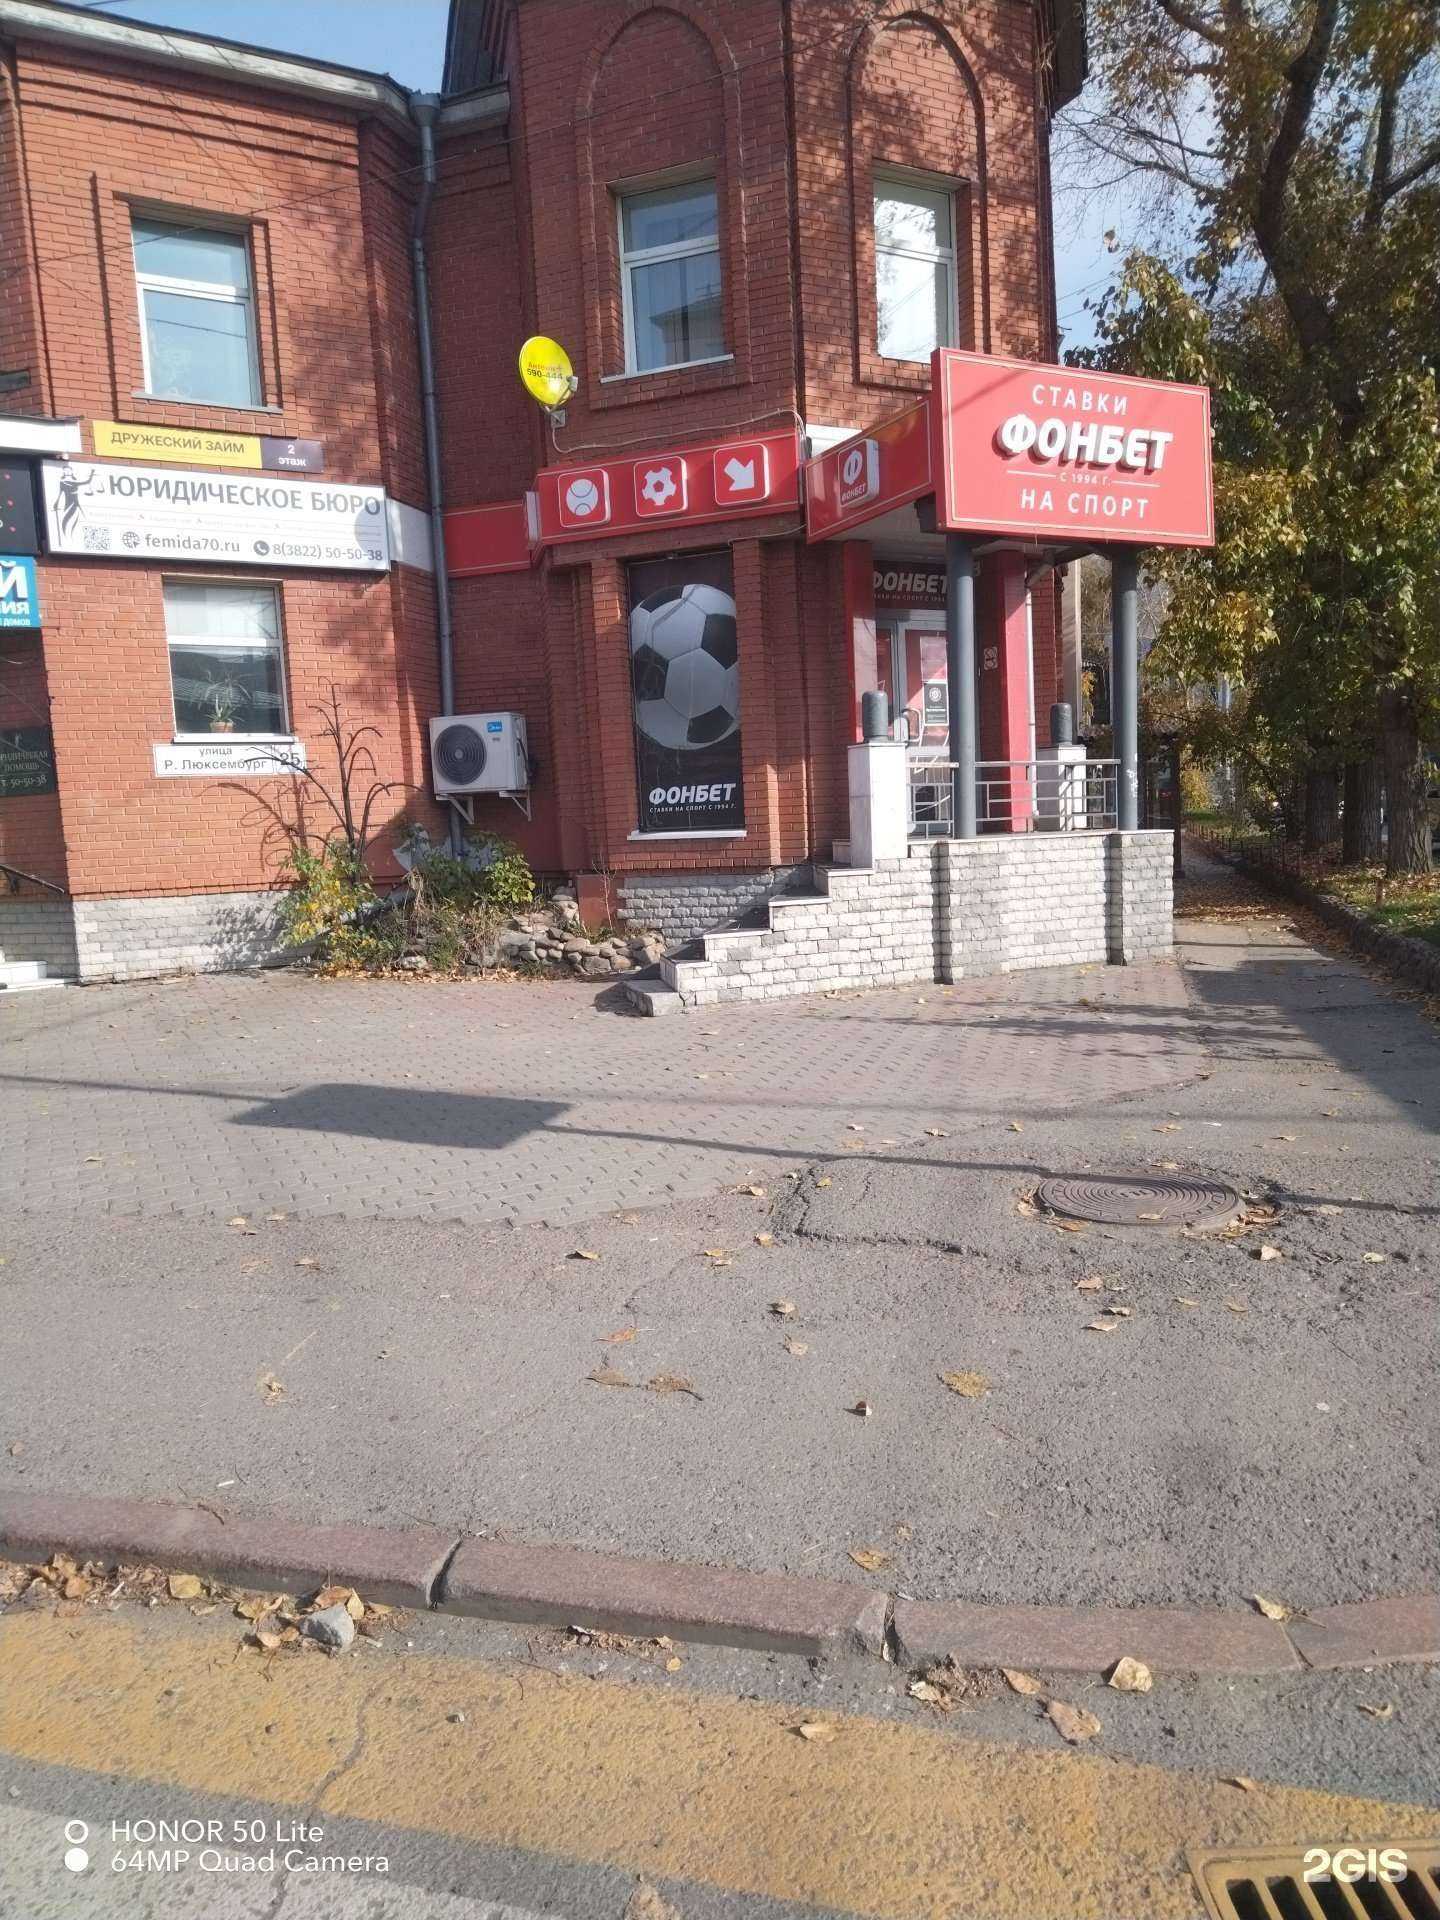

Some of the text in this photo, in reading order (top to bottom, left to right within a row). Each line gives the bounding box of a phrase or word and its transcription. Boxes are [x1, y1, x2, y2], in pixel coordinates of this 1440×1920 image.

[1032, 384, 1128, 416] СТАВКИ
[110, 431, 245, 454] ДРУЖЕСКИЙ ЗАЙМ
[287, 444, 296, 454] 2
[1001, 413, 1174, 470] ФОНБЕТ
[277, 457, 307, 467] этаж
[1059, 472, 1067, 483] С
[1072, 474, 1098, 485] 1994
[108, 474, 381, 516] ЮРИДИЧЕСКОЕ БЮРО
[1021, 488, 1149, 519] НА СПОРТ
[144, 533, 241, 553] femida70.ru
[272, 542, 383, 561] 8(3822) 50-50-38
[199, 747, 233, 757] улица
[279, 752, 301, 766] 25
[164, 759, 267, 772] Р. Люксембург
[649, 783, 737, 805] ФОНБЕТ
[649, 806, 673, 814] СТАВКИ
